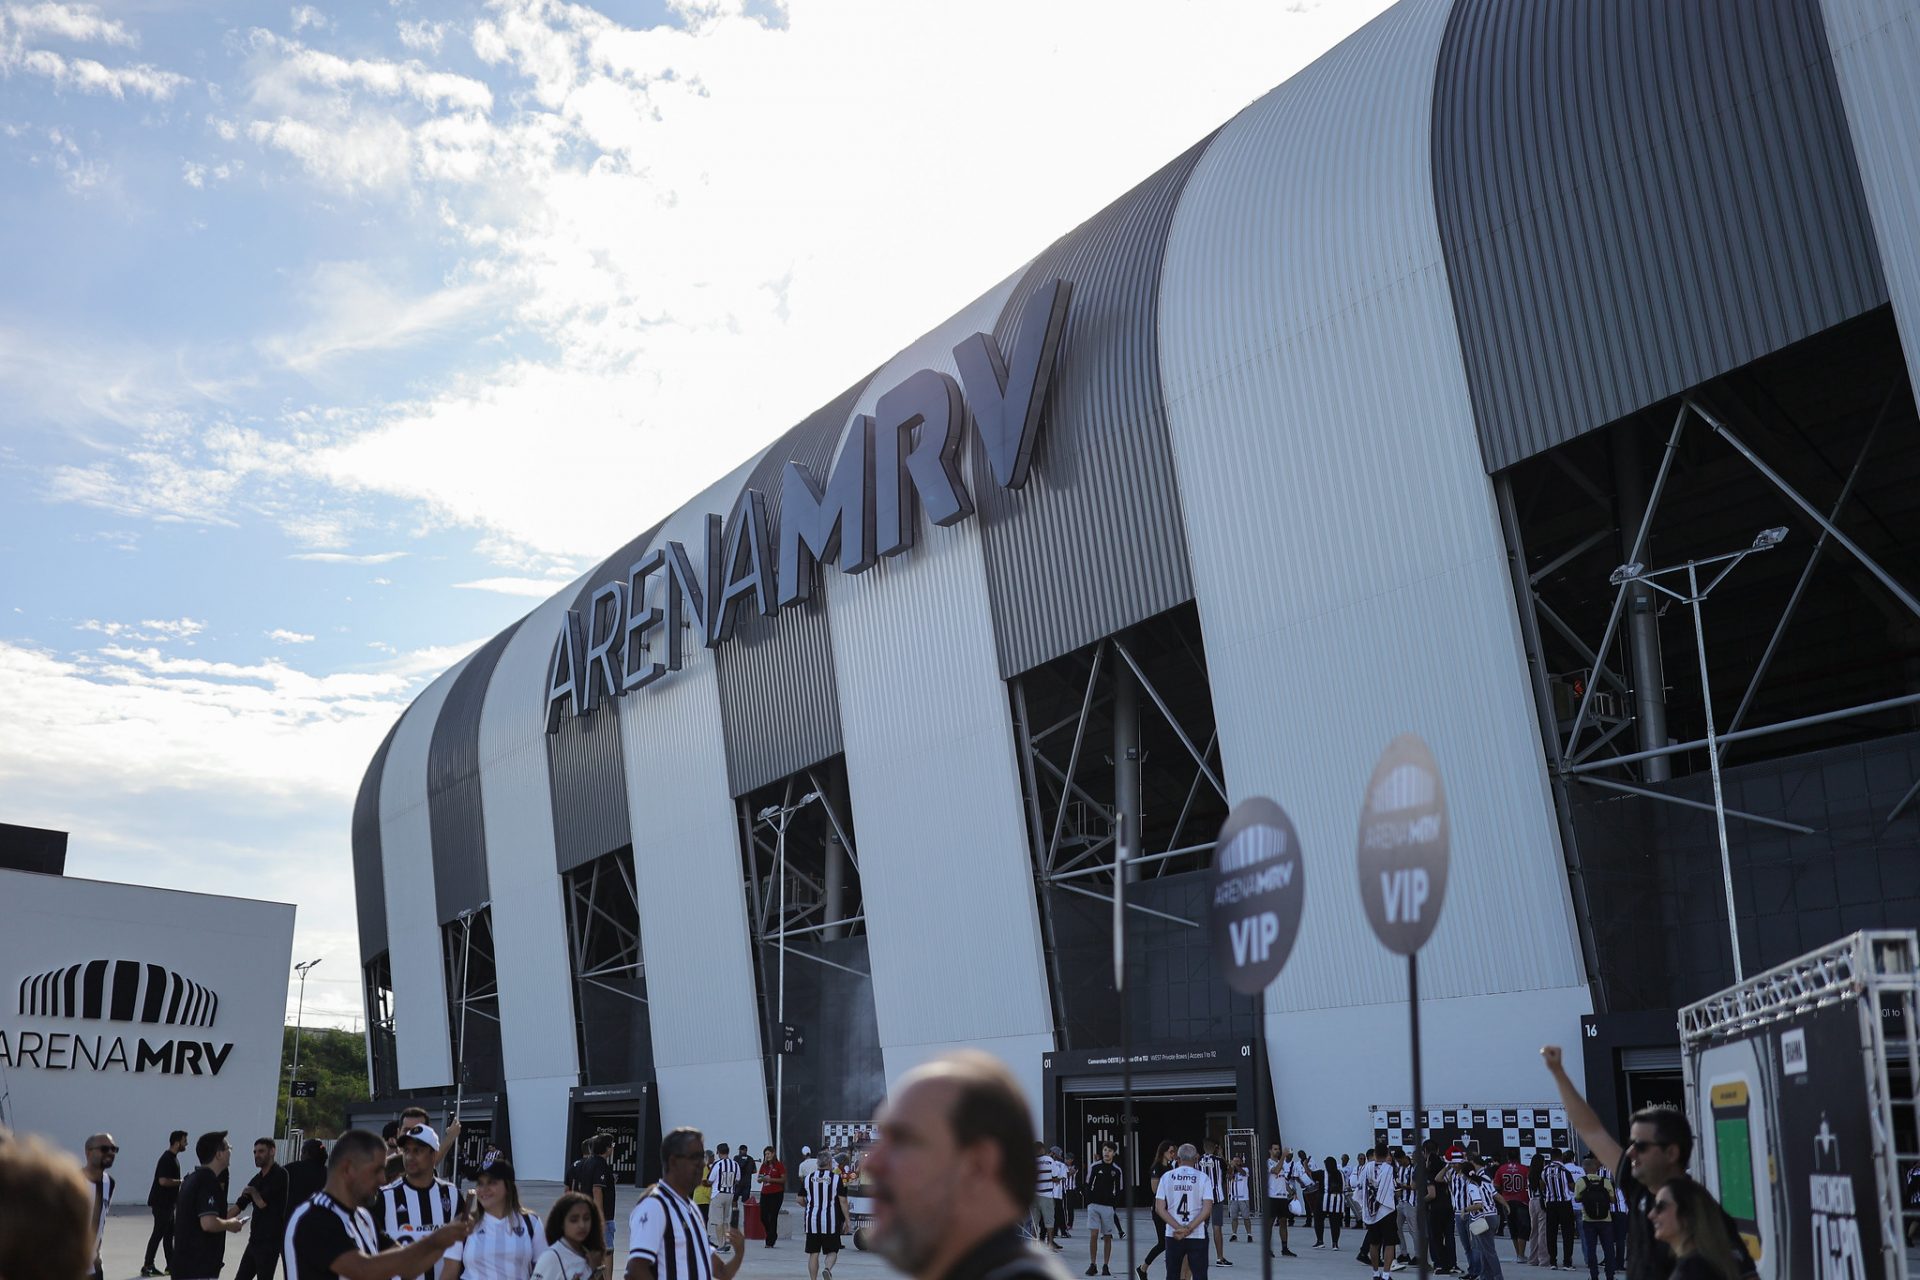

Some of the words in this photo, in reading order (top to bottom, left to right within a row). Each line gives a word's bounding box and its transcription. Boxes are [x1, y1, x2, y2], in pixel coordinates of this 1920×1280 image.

[1381, 867, 1430, 924] VIP
[1229, 912, 1280, 967] VIP
[1585, 1024, 1598, 1037] 16
[785, 1039, 793, 1052] 01
[1241, 1045, 1251, 1056] 01
[1044, 1059, 1051, 1069] 01
[1087, 1114, 1115, 1124] Portão
[1177, 1174, 1197, 1184] bmg
[1502, 1174, 1523, 1193] 20
[1176, 1193, 1190, 1222] 4
